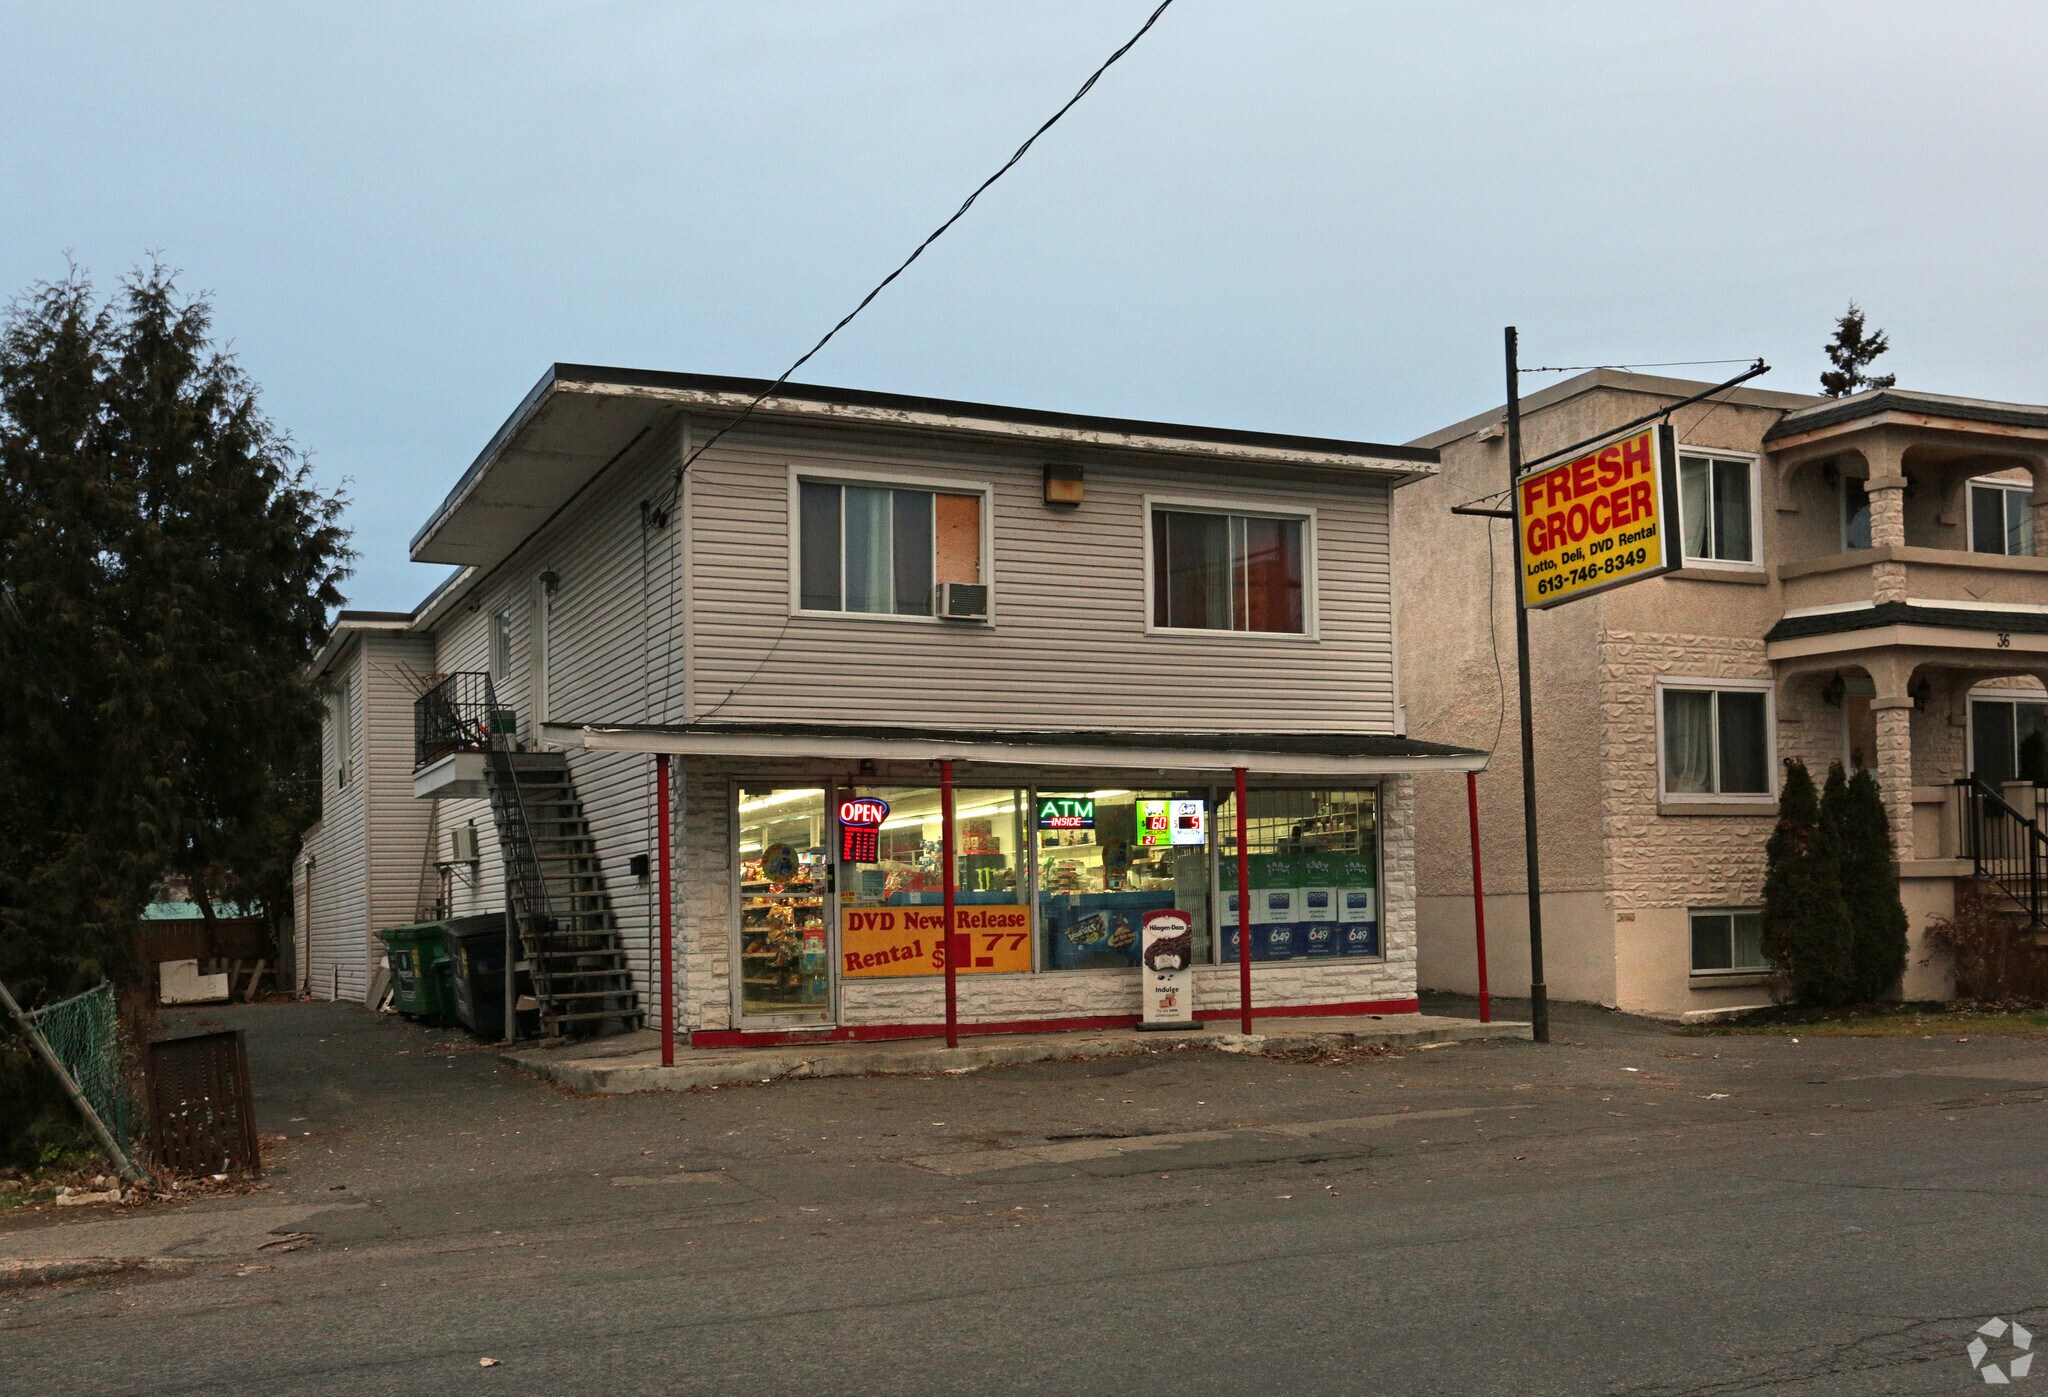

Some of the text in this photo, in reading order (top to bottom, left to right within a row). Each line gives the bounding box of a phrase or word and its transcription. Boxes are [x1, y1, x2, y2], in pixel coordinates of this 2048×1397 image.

[1523, 434, 1652, 516] FRESH
[1527, 480, 1653, 556] GROCER
[1527, 523, 1657, 576] Lotto, Deli, DVD Rental
[1538, 547, 1647, 595] 613-746-8349
[1997, 633, 2010, 648] 36
[841, 803, 882, 822] OPEN
[1040, 801, 1093, 817] ATM
[1051, 817, 1082, 826] INSIDE
[1191, 816, 1199, 829] 5
[848, 911, 1025, 931] DVD New Release
[1270, 929, 1290, 943] 649
[1309, 927, 1328, 940] 649
[1349, 928, 1367, 941] 649
[845, 940, 924, 971] Rental
[1155, 986, 1179, 994] Indulge
